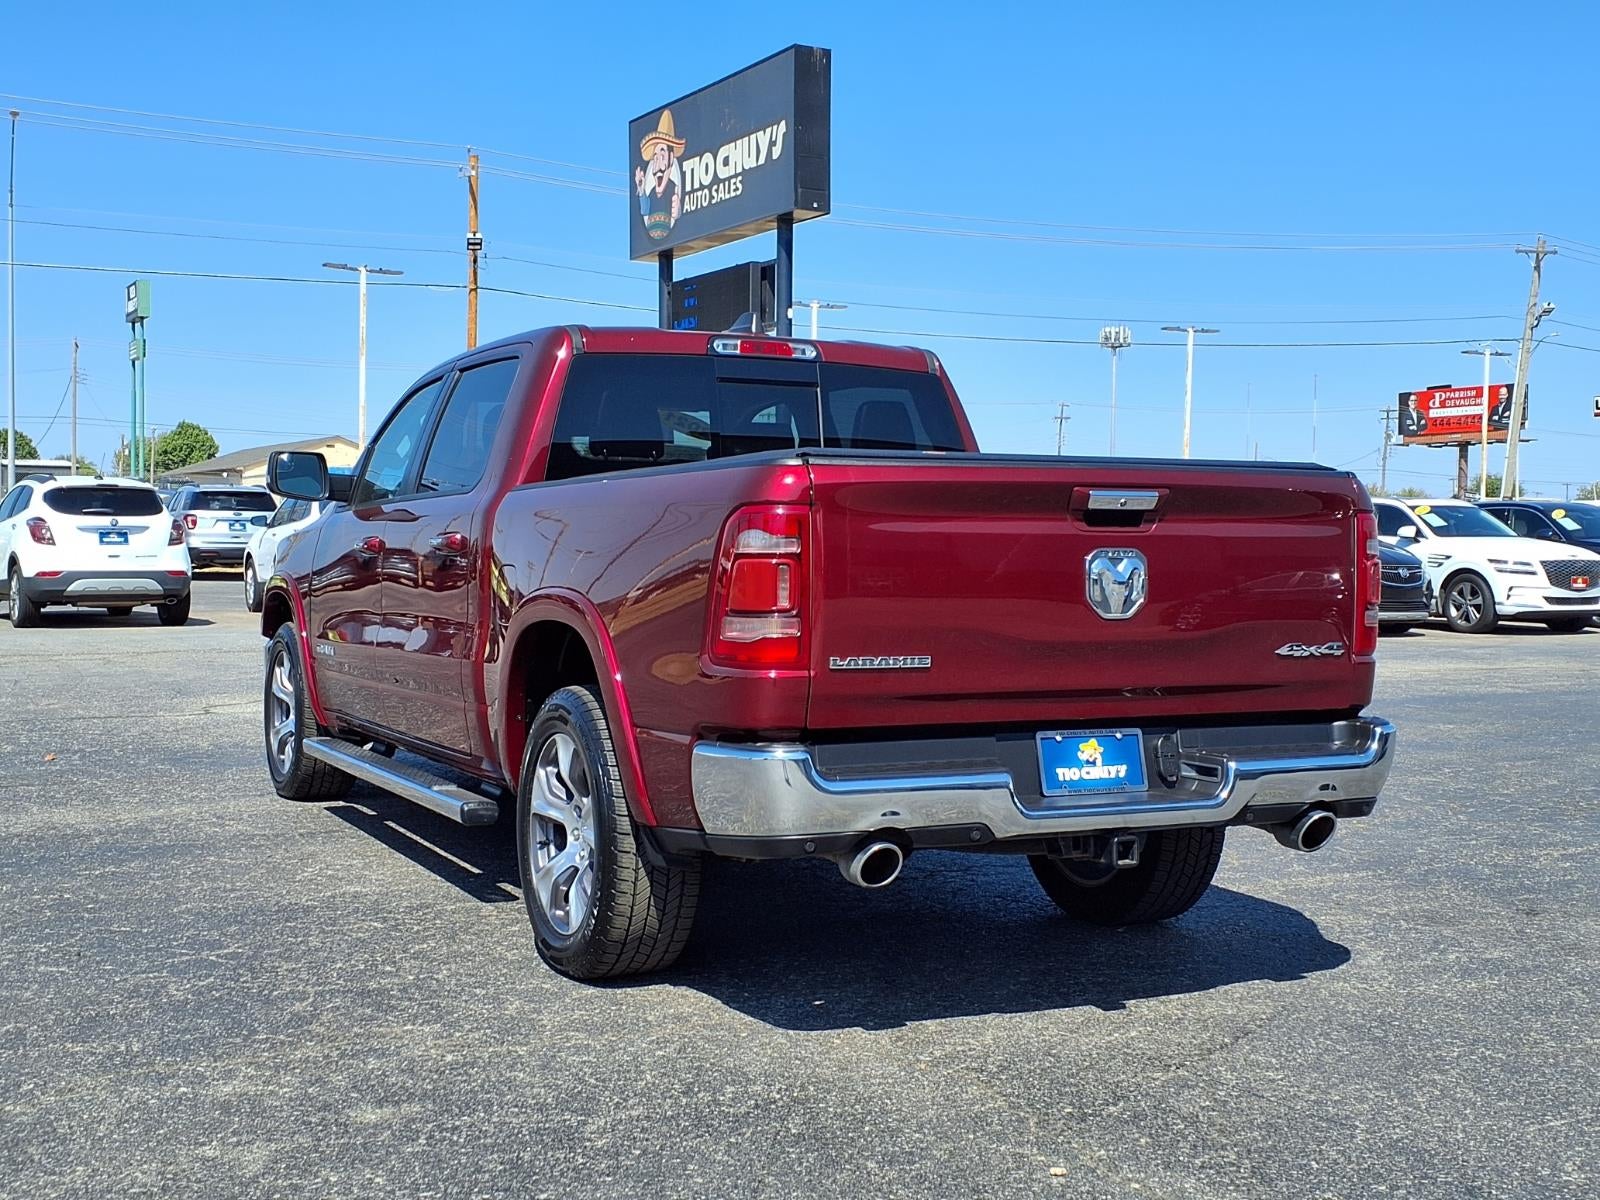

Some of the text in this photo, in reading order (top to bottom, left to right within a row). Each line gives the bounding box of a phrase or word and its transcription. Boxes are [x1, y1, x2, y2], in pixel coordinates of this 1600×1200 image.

[683, 120, 786, 192] TIO CHUY'S
[683, 176, 742, 213] AUTO SALES
[1446, 390, 1476, 398] PARRISH
[829, 656, 931, 669] LARAMIE
[1056, 765, 1127, 781] TIO CHUY'S
